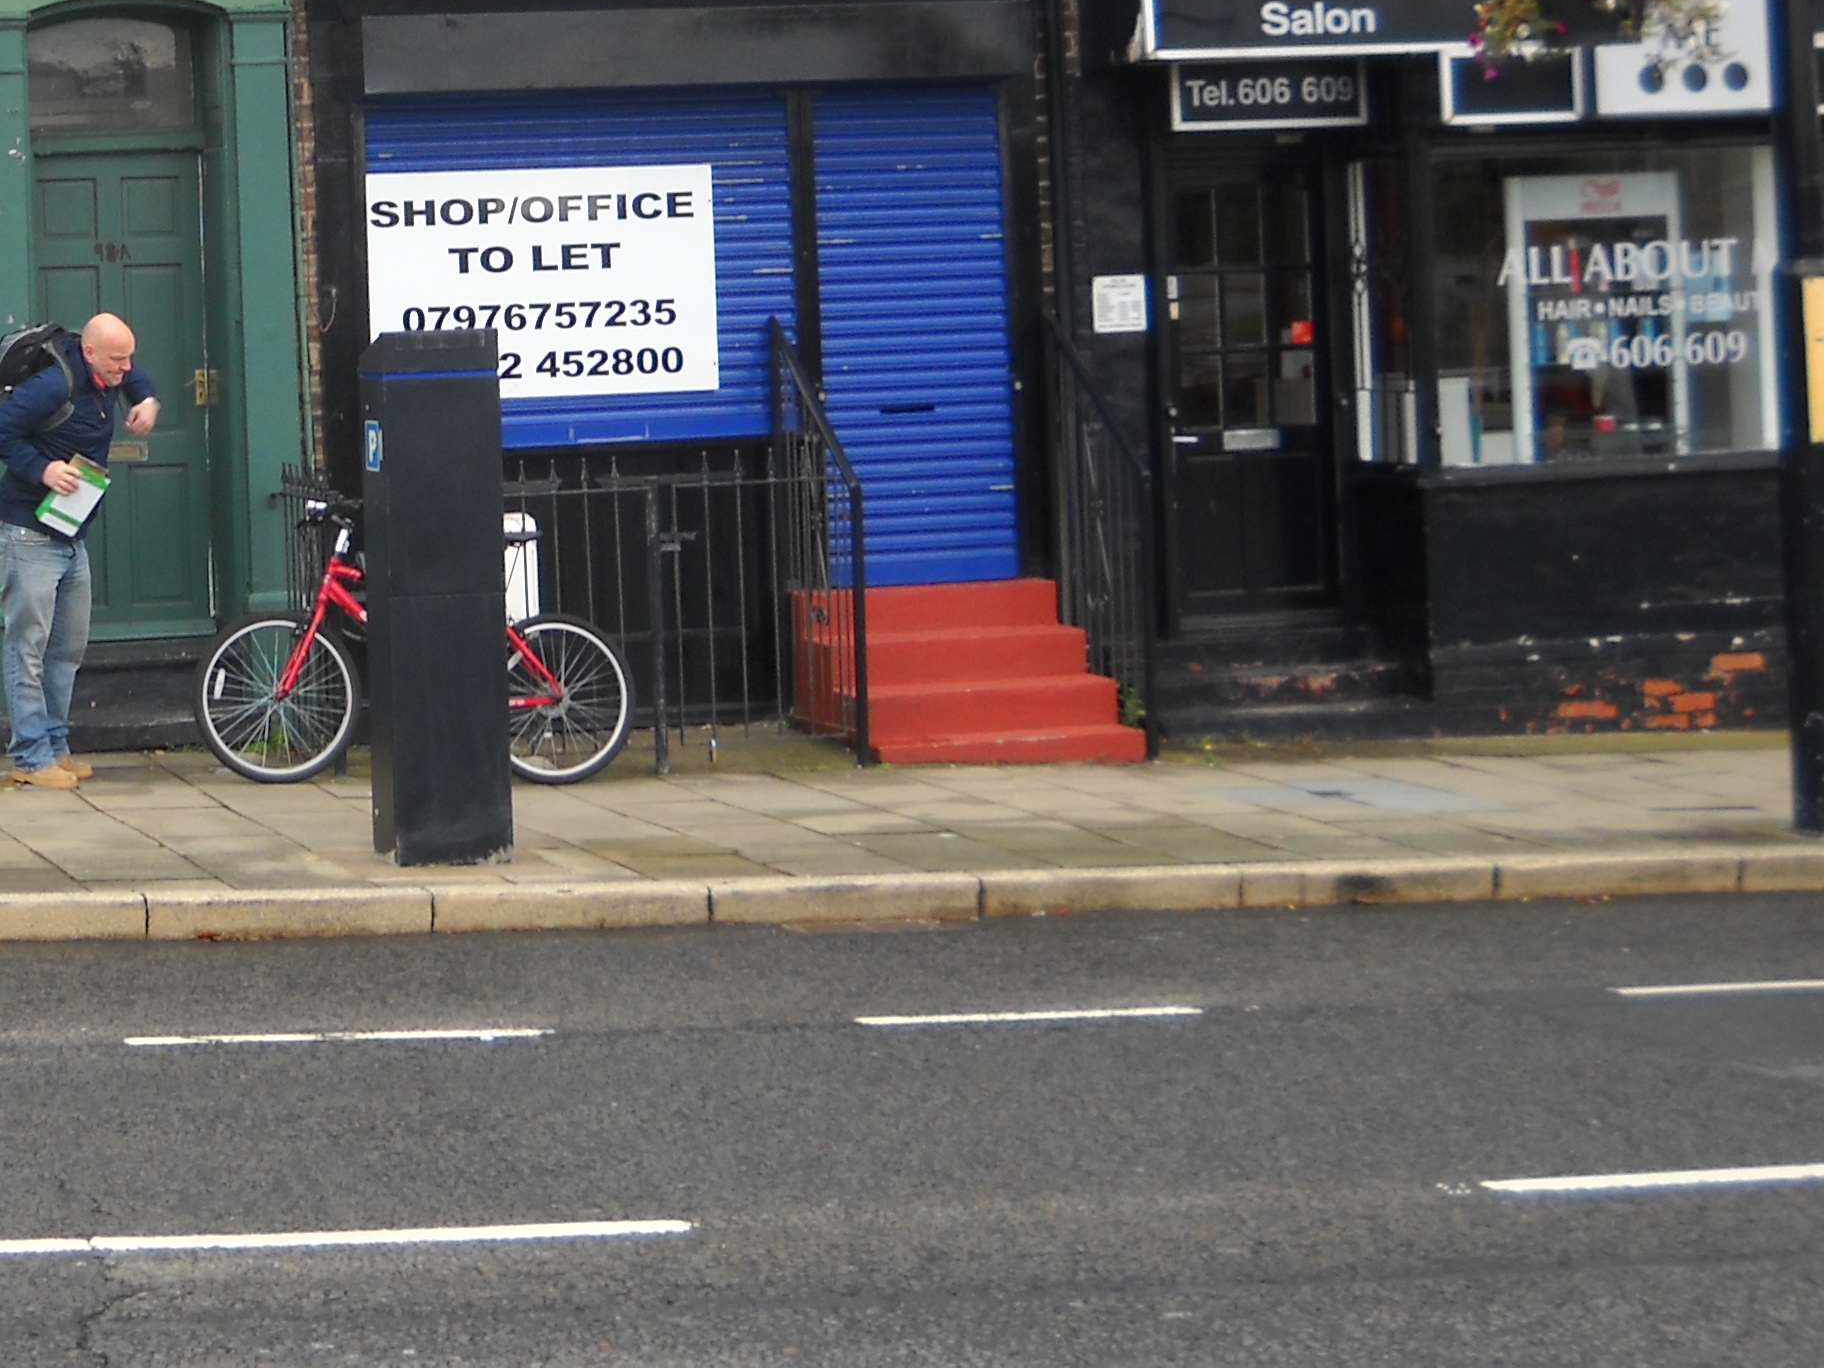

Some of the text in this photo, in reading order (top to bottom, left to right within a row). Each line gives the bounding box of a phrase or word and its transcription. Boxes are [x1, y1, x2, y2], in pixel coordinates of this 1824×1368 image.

[1260, 0, 1376, 36] Salon
[1300, 76, 1354, 103] 609
[370, 191, 695, 228] SHOP/OFFICE
[448, 242, 621, 274] TO LET
[1497, 244, 1572, 286] ALL
[1583, 238, 1738, 282] ABOUT
[402, 299, 677, 332] 07976757235
[1537, 290, 1763, 321] HAIR NAILS BEAUT
[536, 346, 684, 379] 452800
[1611, 330, 1748, 368] 606 609
